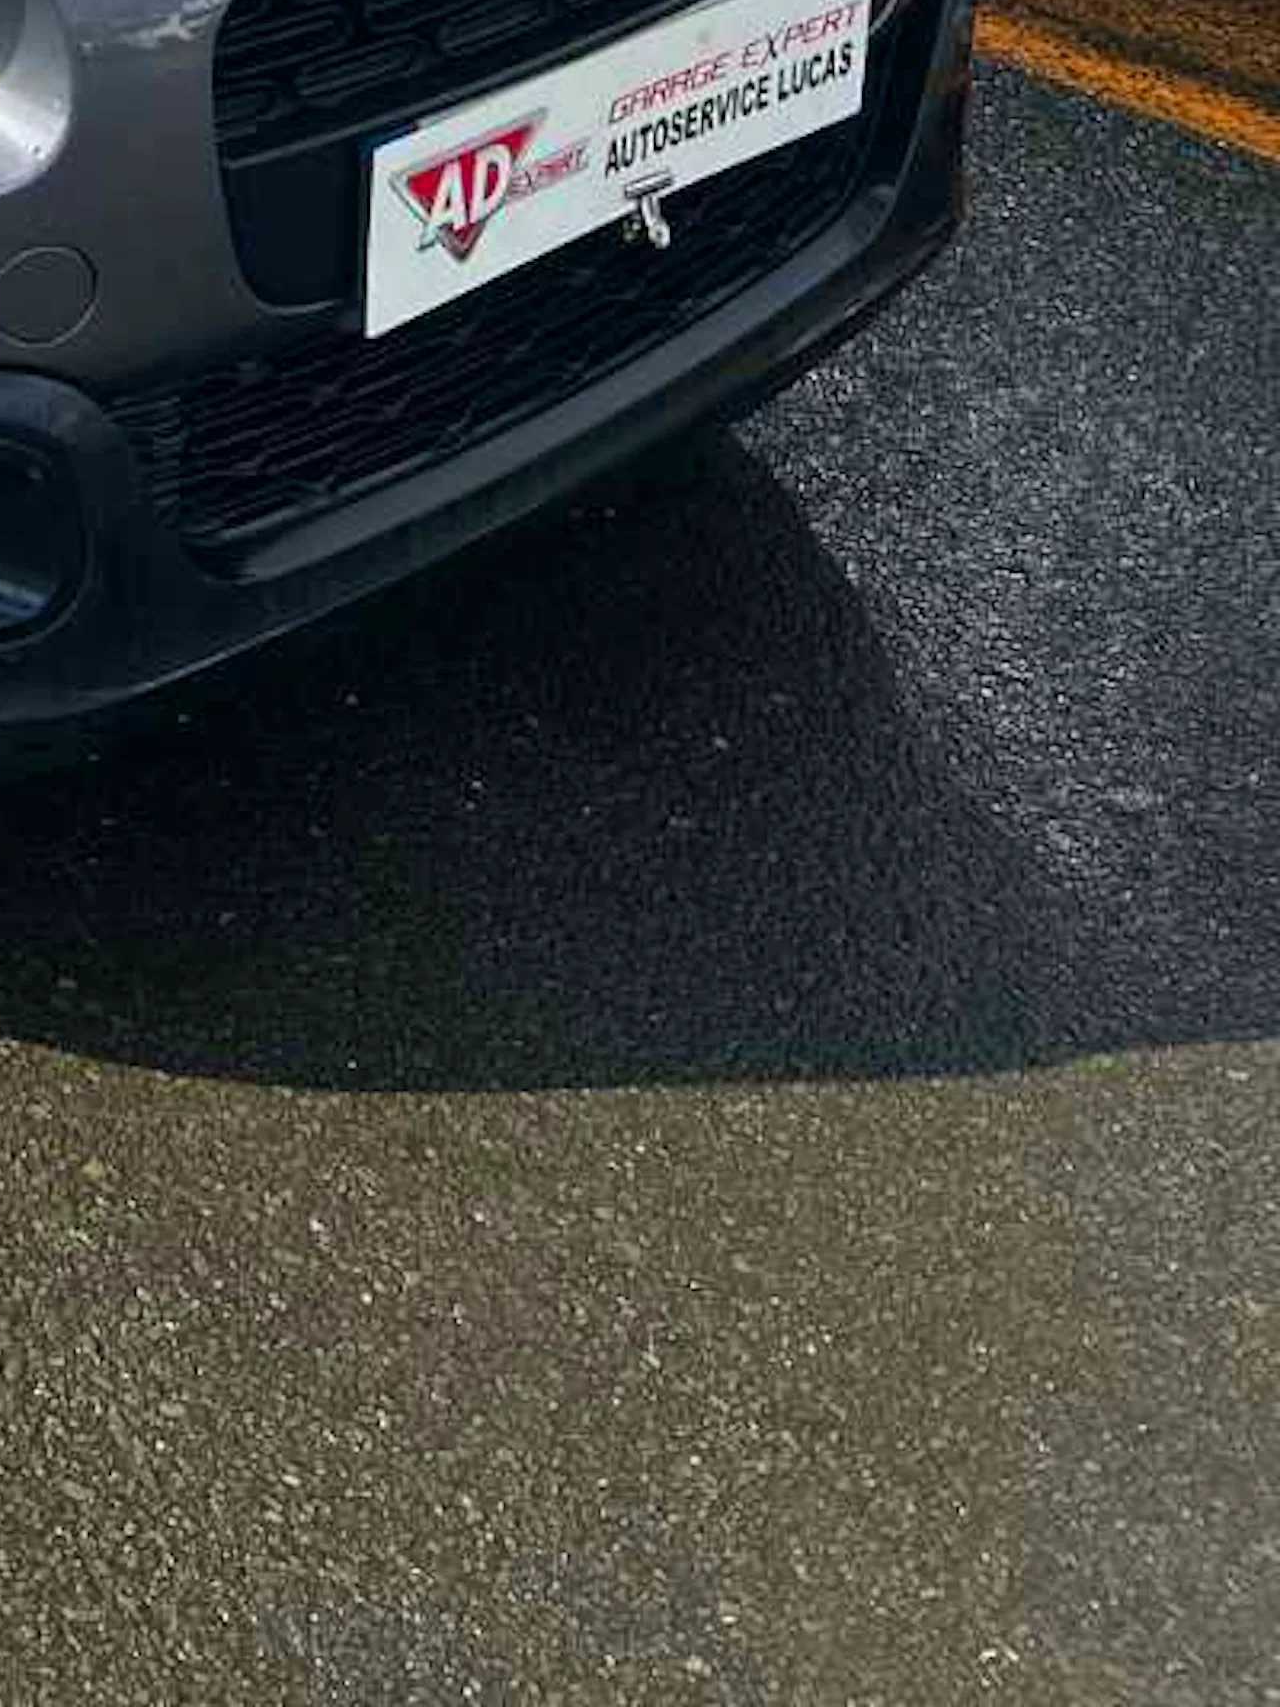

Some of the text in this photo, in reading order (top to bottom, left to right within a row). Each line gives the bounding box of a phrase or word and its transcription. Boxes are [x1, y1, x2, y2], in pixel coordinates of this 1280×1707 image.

[605, 41, 853, 178] AUTOSERVICE LUCAS
[610, 0, 864, 124] GARAGE EXPERT
[417, 143, 511, 249] AD
